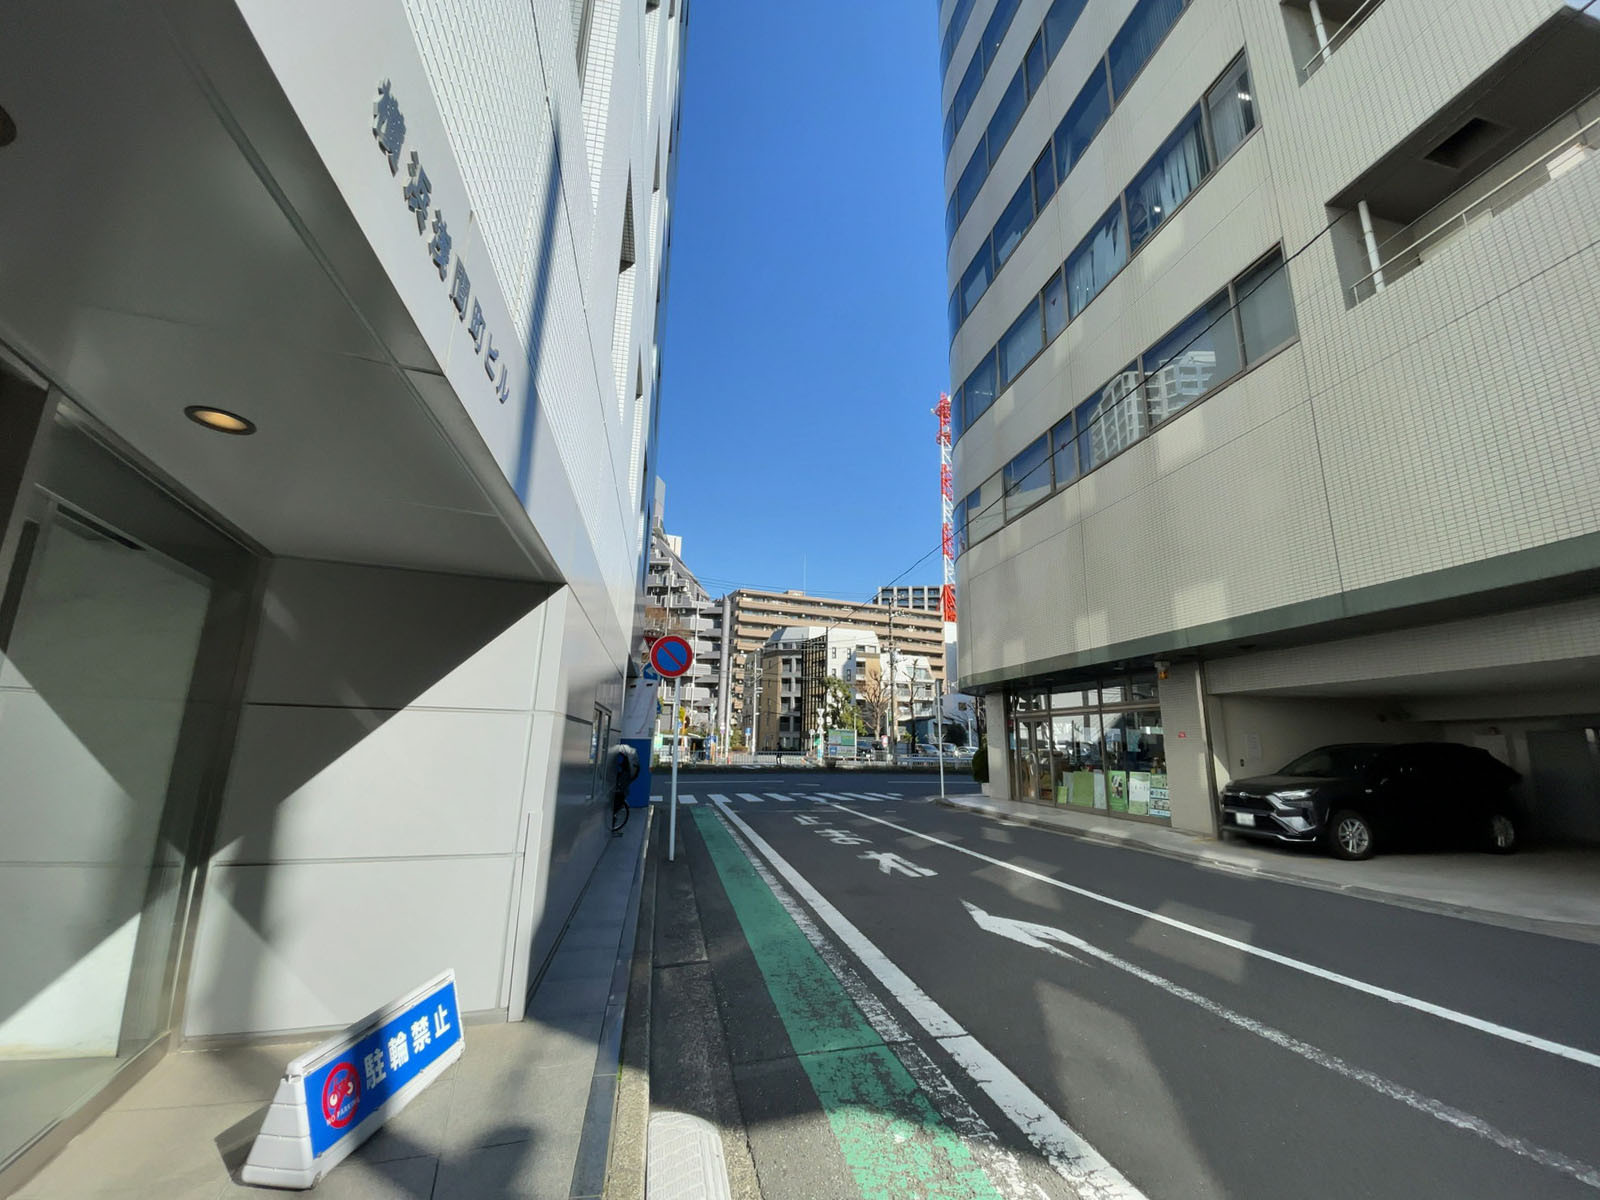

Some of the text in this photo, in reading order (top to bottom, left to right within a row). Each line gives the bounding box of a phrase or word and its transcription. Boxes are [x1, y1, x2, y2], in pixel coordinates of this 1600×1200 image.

[793, 814, 939, 878] 止まれ
[363, 1003, 451, 1090] 駐輪禁止
